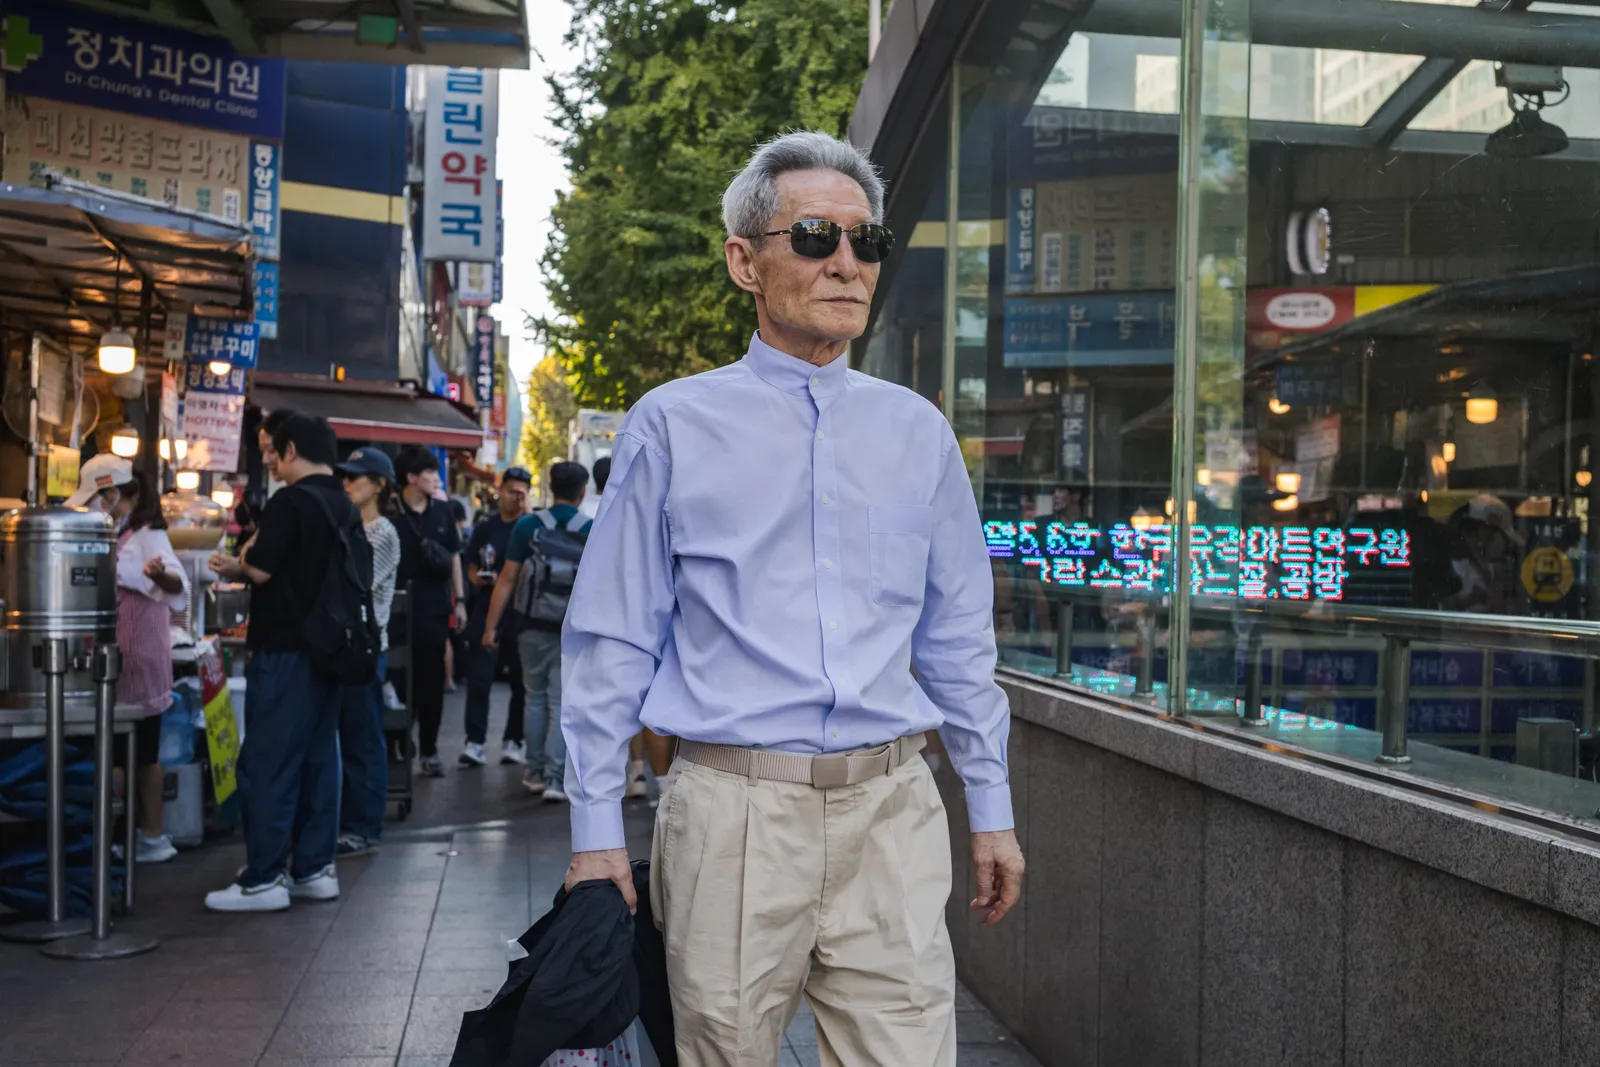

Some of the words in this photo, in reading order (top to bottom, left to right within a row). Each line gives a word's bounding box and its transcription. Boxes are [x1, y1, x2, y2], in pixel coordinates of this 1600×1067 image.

[66, 27, 260, 101] 정치과의원
[159, 88, 210, 111] Dental
[215, 99, 258, 119] Clinic
[210, 335, 256, 362] 부꾸미
